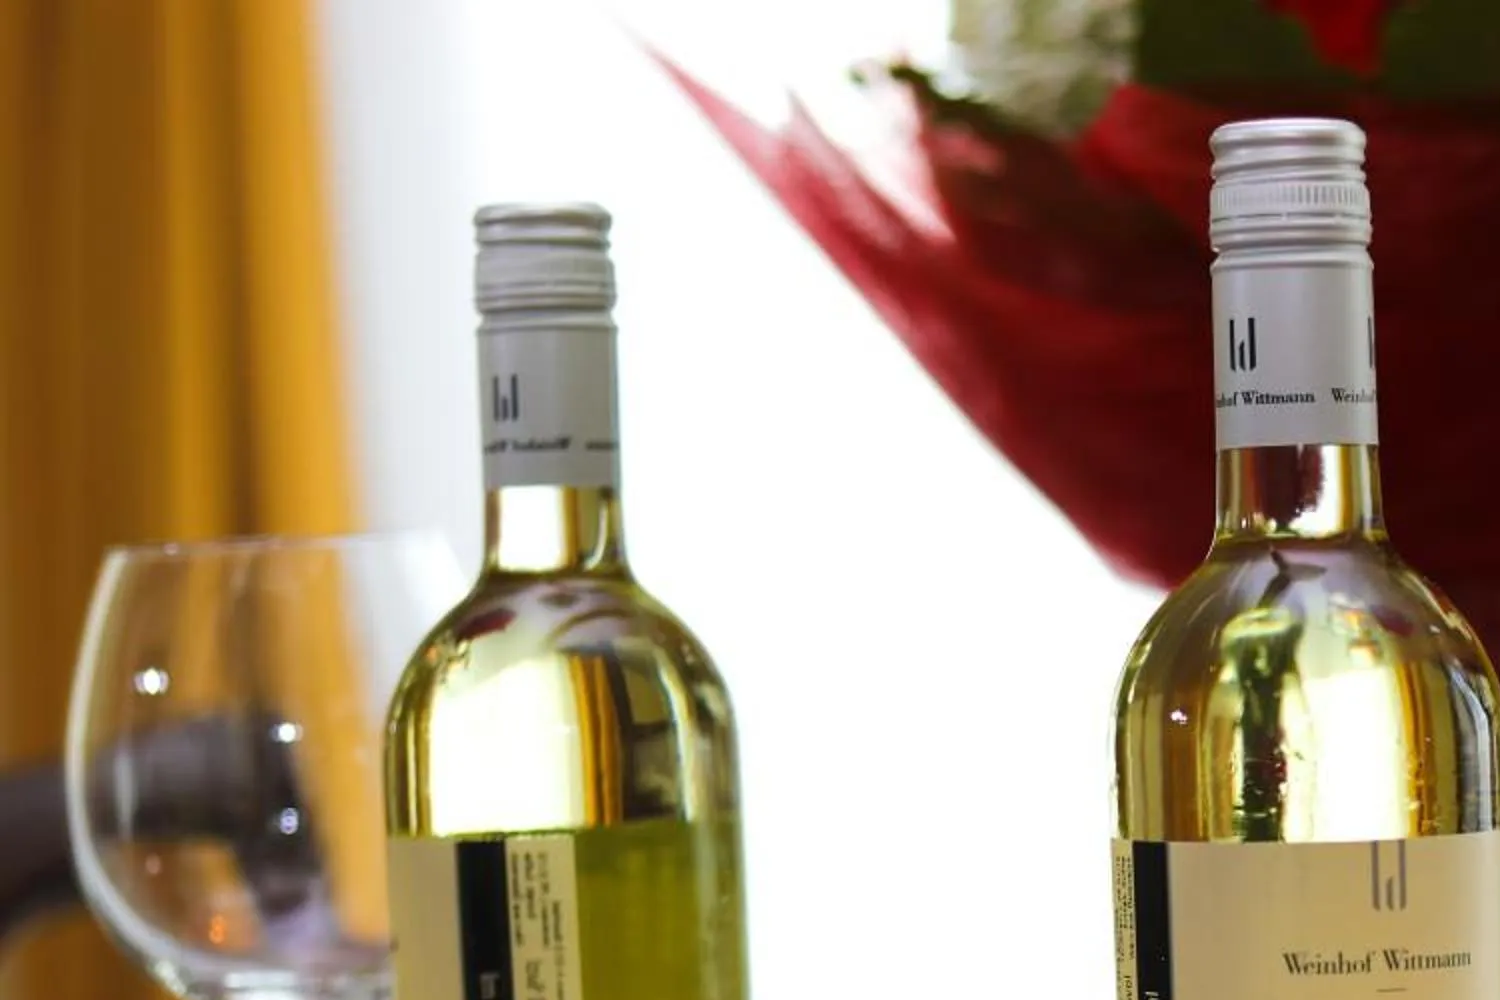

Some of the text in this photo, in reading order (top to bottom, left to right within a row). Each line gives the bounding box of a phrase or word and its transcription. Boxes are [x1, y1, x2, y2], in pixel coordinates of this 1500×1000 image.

[1242, 390, 1316, 405] Wittmann
[1283, 949, 1471, 976] Weinhof Wittmann
